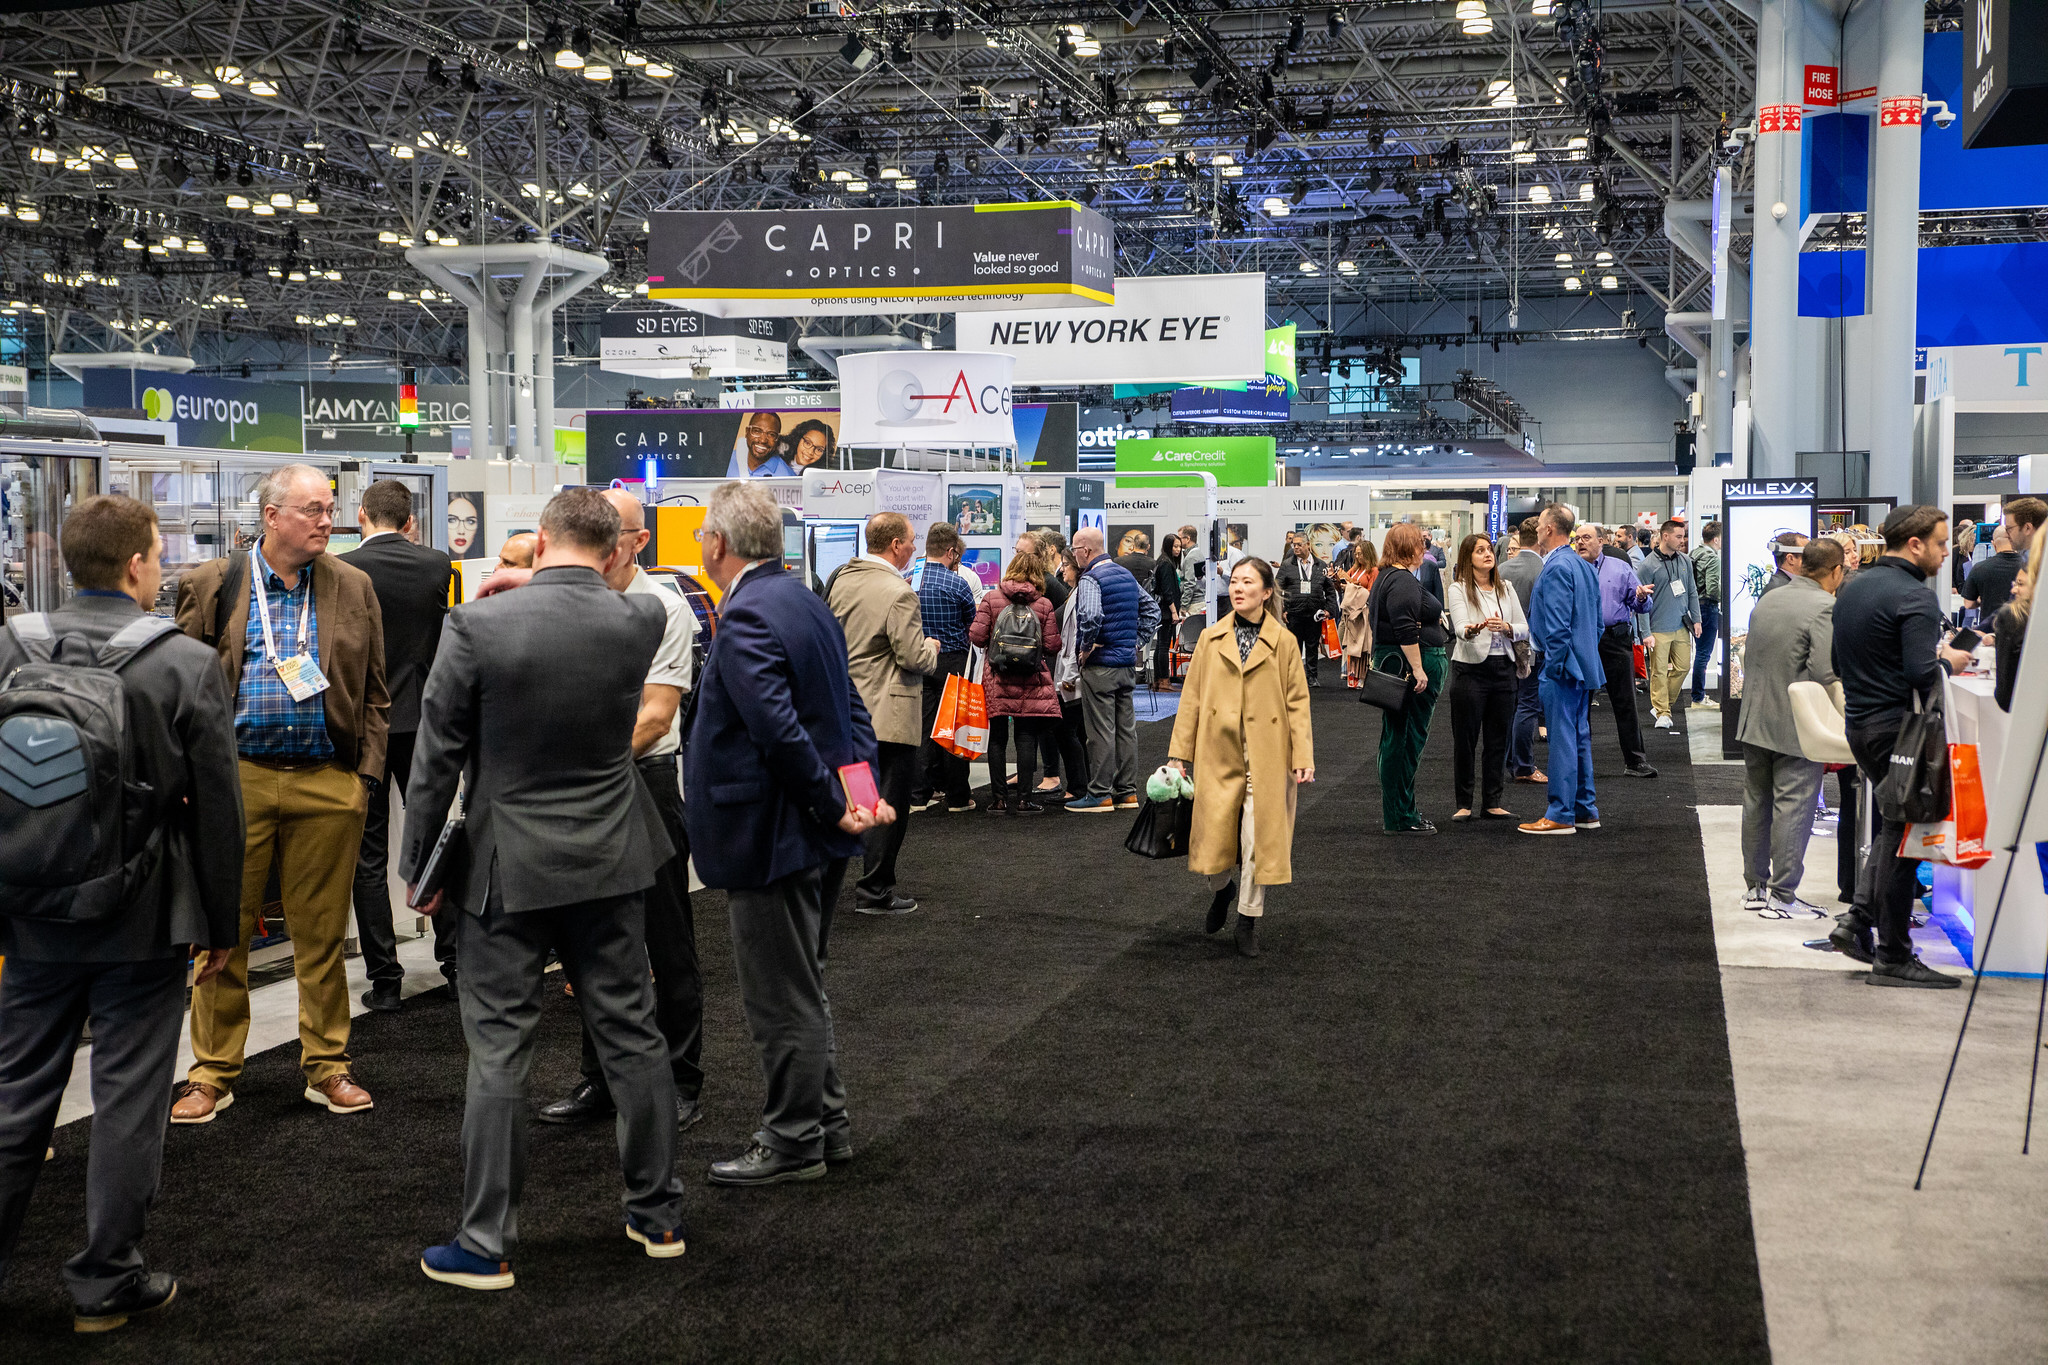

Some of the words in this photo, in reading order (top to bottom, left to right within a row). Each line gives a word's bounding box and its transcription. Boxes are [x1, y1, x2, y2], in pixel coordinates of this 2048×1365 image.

[1812, 72, 1831, 84] FIRE
[1809, 87, 1833, 100] HOSE
[1863, 89, 1876, 97] Valve
[765, 221, 942, 252] CAPRI
[1077, 225, 1109, 259] CAPRI
[973, 251, 1006, 263] Value
[1008, 252, 1040, 262] never
[810, 266, 896, 279] OPTICS
[974, 263, 1012, 275] looked
[1013, 264, 1027, 274] so
[1029, 261, 1059, 276] good
[1085, 265, 1102, 278] OPTICS
[811, 297, 847, 306] options
[851, 296, 877, 306] using
[917, 294, 964, 305] polarized
[967, 292, 1024, 303] technology
[636, 317, 657, 333] SD
[661, 316, 698, 333] EYES
[748, 318, 758, 335] SD
[759, 319, 773, 336] EYES
[990, 321, 1062, 345] NEW
[1067, 318, 1152, 344] YORK
[1159, 316, 1221, 341] EYE
[5, 374, 23, 385] PARK
[1930, 354, 1947, 399] TURA
[943, 369, 1012, 416] Ace
[785, 395, 797, 406] SD
[799, 395, 822, 405] EYES
[176, 394, 259, 442] europa
[372, 400, 470, 422] AERIC
[615, 431, 703, 447] CAPRI
[1165, 450, 1226, 462] CareCredit
[770, 485, 802, 505] OLLECTI
[833, 480, 872, 496] Acep
[912, 485, 924, 493] got
[1726, 482, 1798, 496] WILEY
[1800, 482, 1816, 494] X
[911, 494, 926, 502] with
[1104, 500, 1132, 510] marie
[1132, 499, 1160, 510] claire
[505, 506, 542, 518] Enhanc
